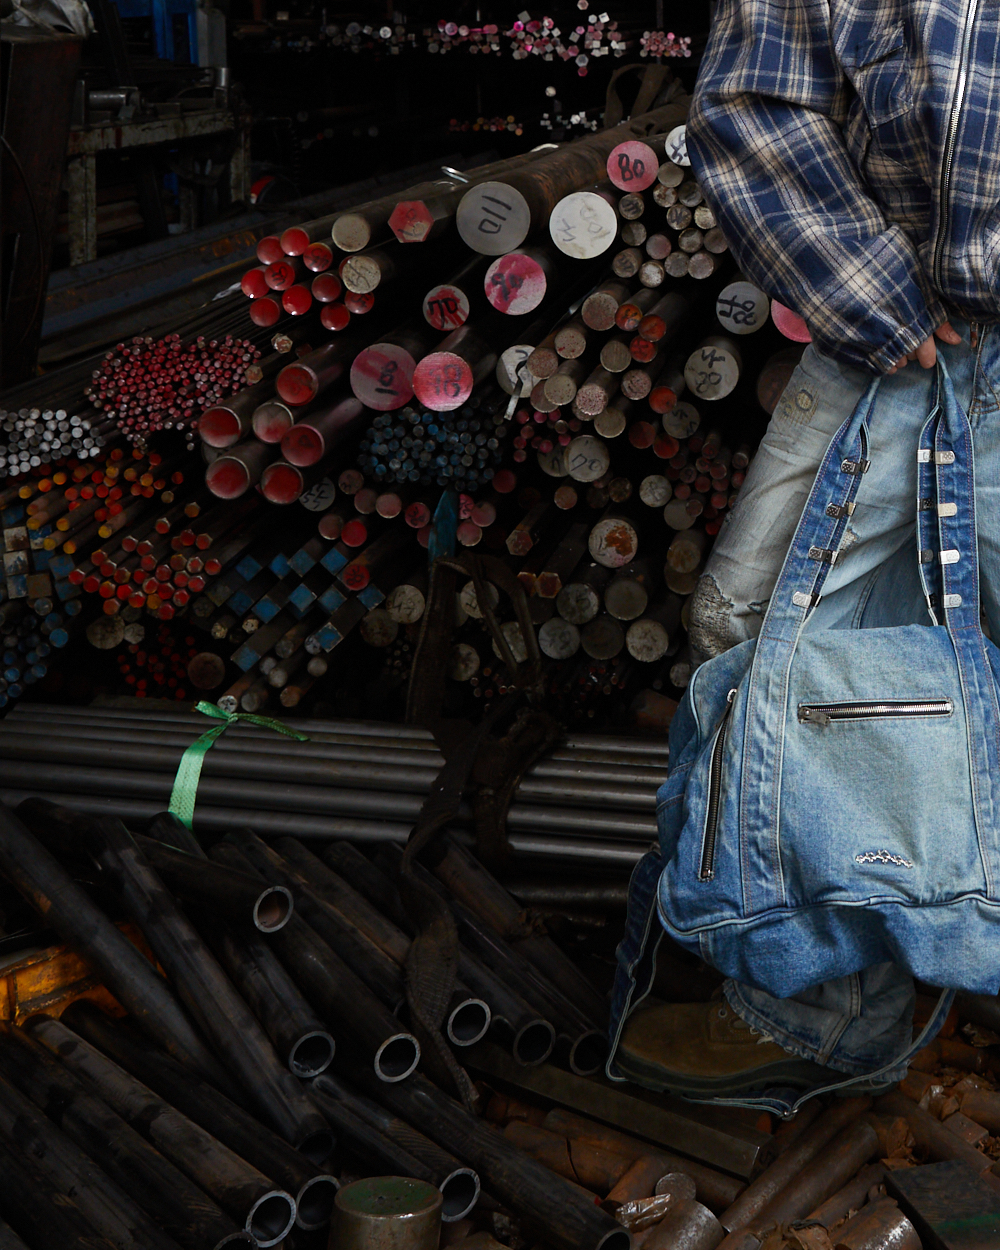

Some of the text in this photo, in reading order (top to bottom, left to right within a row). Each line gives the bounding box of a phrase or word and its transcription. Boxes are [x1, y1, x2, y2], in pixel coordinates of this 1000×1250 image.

[617, 153, 645, 182] 80
[490, 273, 524, 301] 90
[427, 297, 458, 329] 70
